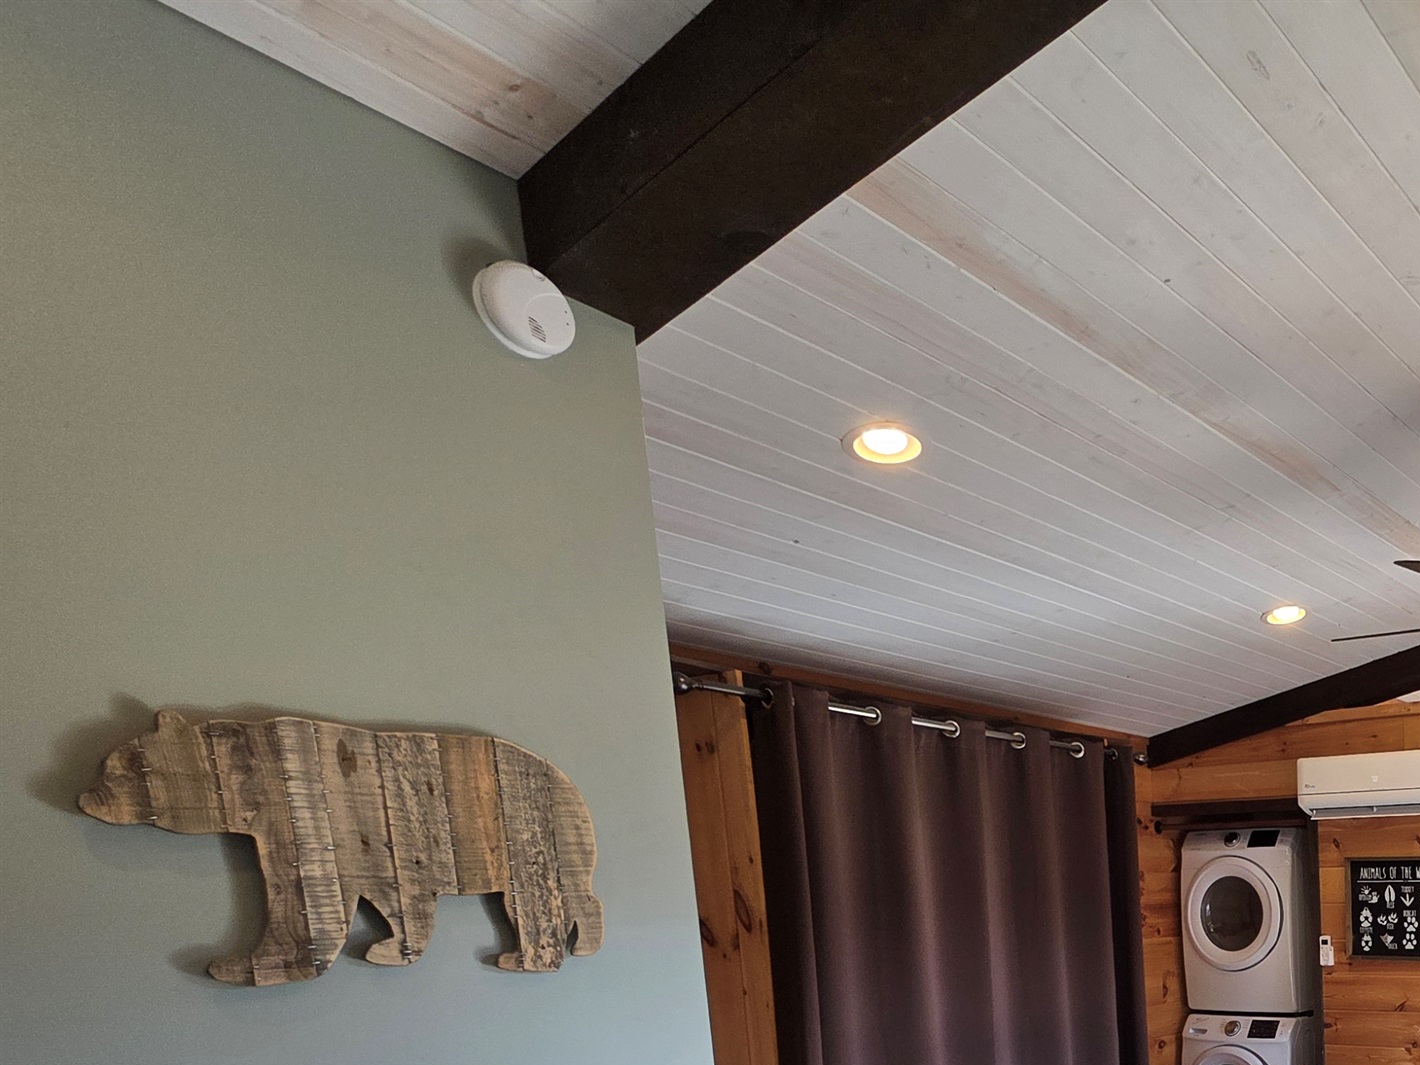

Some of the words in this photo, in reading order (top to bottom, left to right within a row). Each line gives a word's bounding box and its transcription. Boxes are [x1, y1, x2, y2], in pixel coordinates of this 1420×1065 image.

[1360, 866, 1387, 880] ANIMALS
[1389, 866, 1397, 880] OF
[1401, 866, 1412, 880] THE
